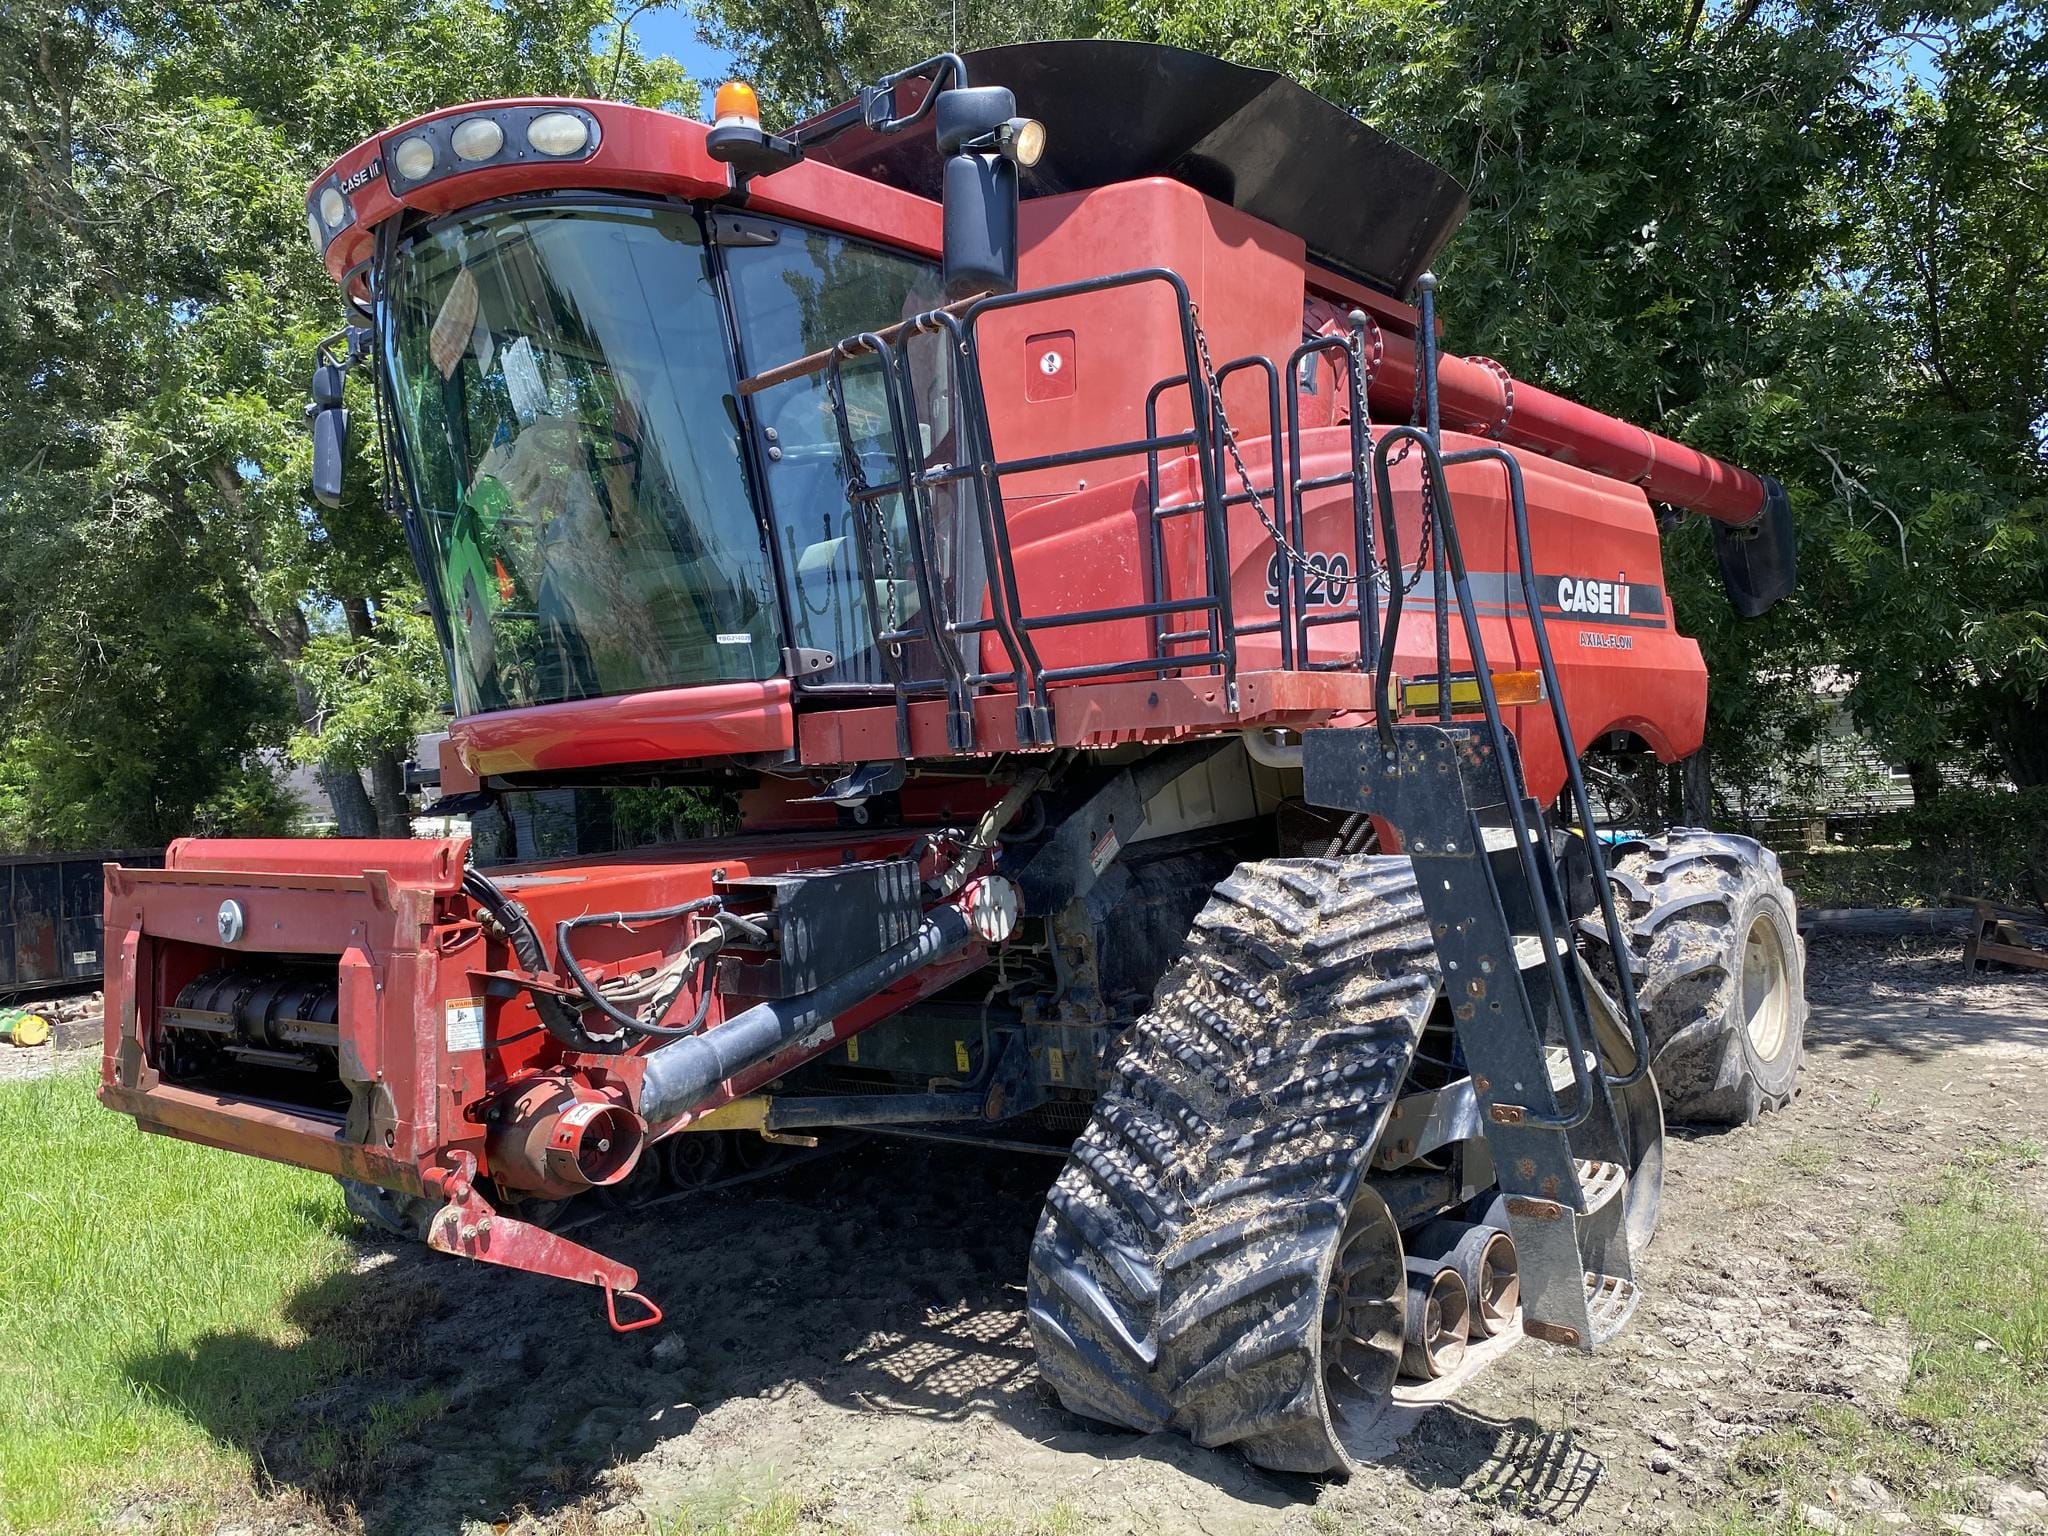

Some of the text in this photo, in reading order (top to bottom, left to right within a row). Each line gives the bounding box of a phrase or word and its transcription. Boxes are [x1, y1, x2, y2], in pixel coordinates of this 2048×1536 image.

[341, 169, 368, 194] CASE
[1264, 552, 1350, 608] 920
[1558, 577, 1612, 614] CASE
[1580, 631, 1633, 650] AXIAL-FLOW
